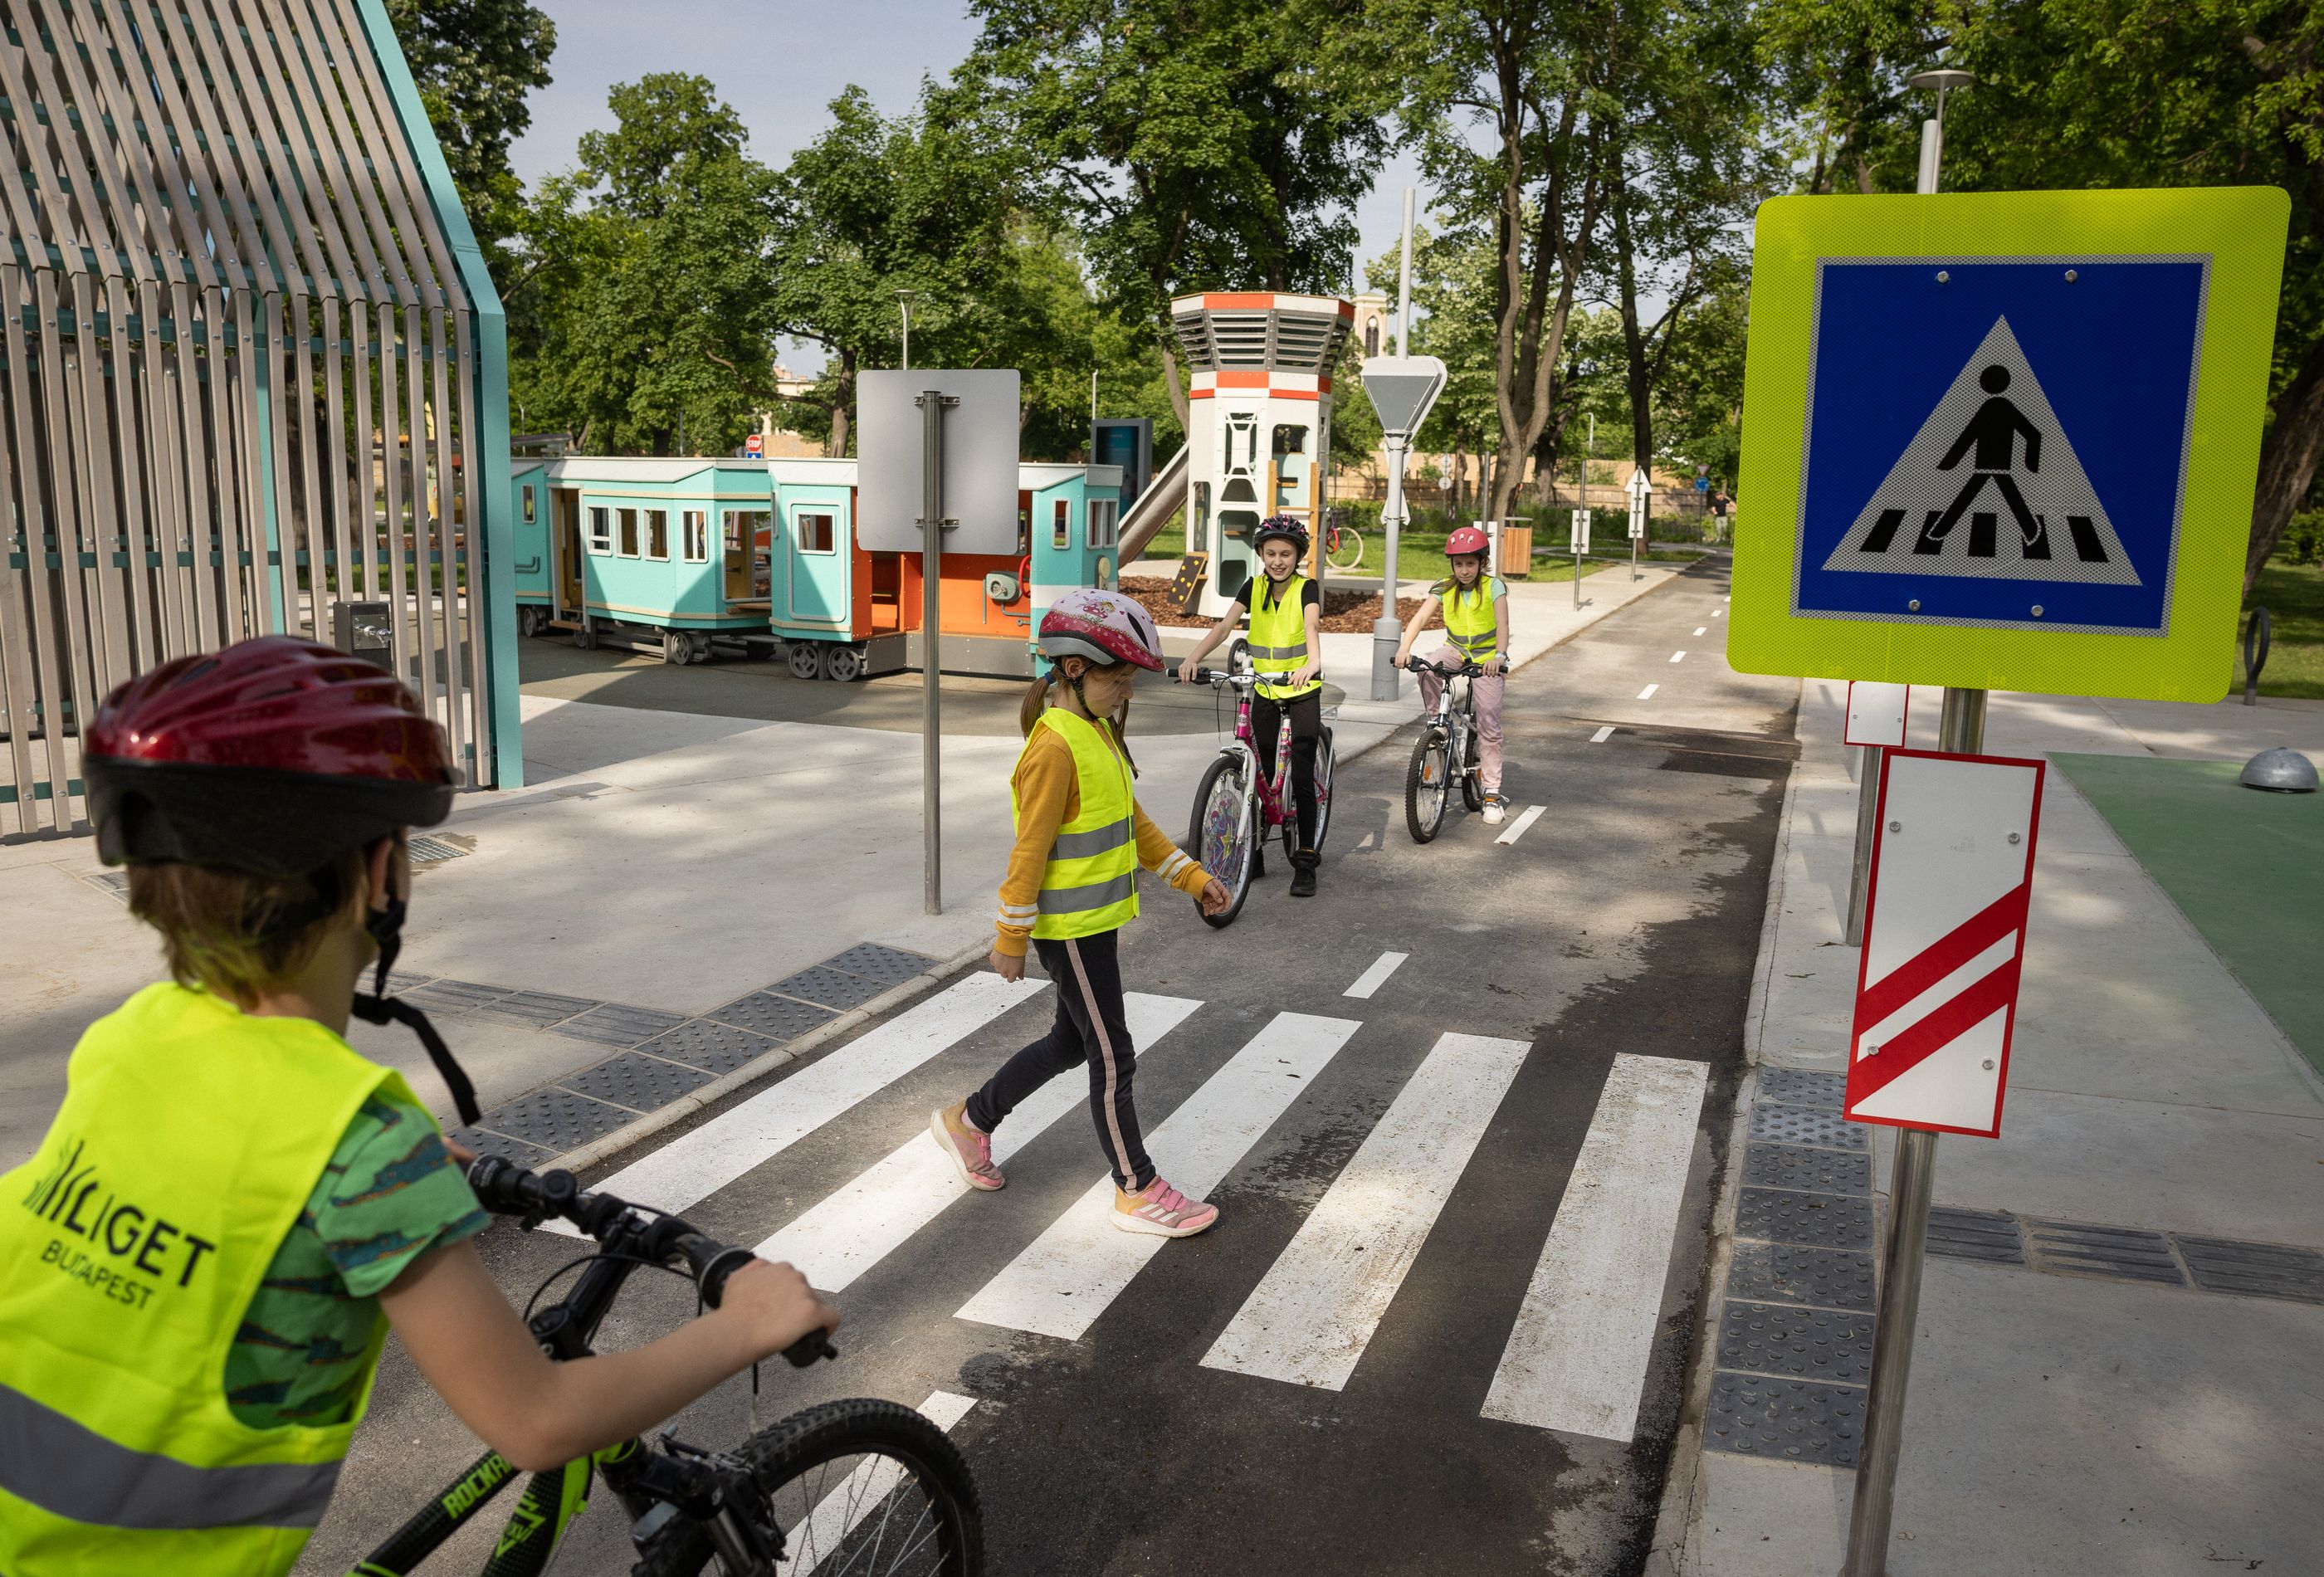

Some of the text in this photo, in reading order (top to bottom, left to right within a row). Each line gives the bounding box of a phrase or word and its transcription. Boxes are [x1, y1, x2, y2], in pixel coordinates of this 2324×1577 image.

[747, 440, 761, 448] STOP
[63, 1179, 216, 1287] LIGET
[442, 1454, 511, 1520] ROCKR
